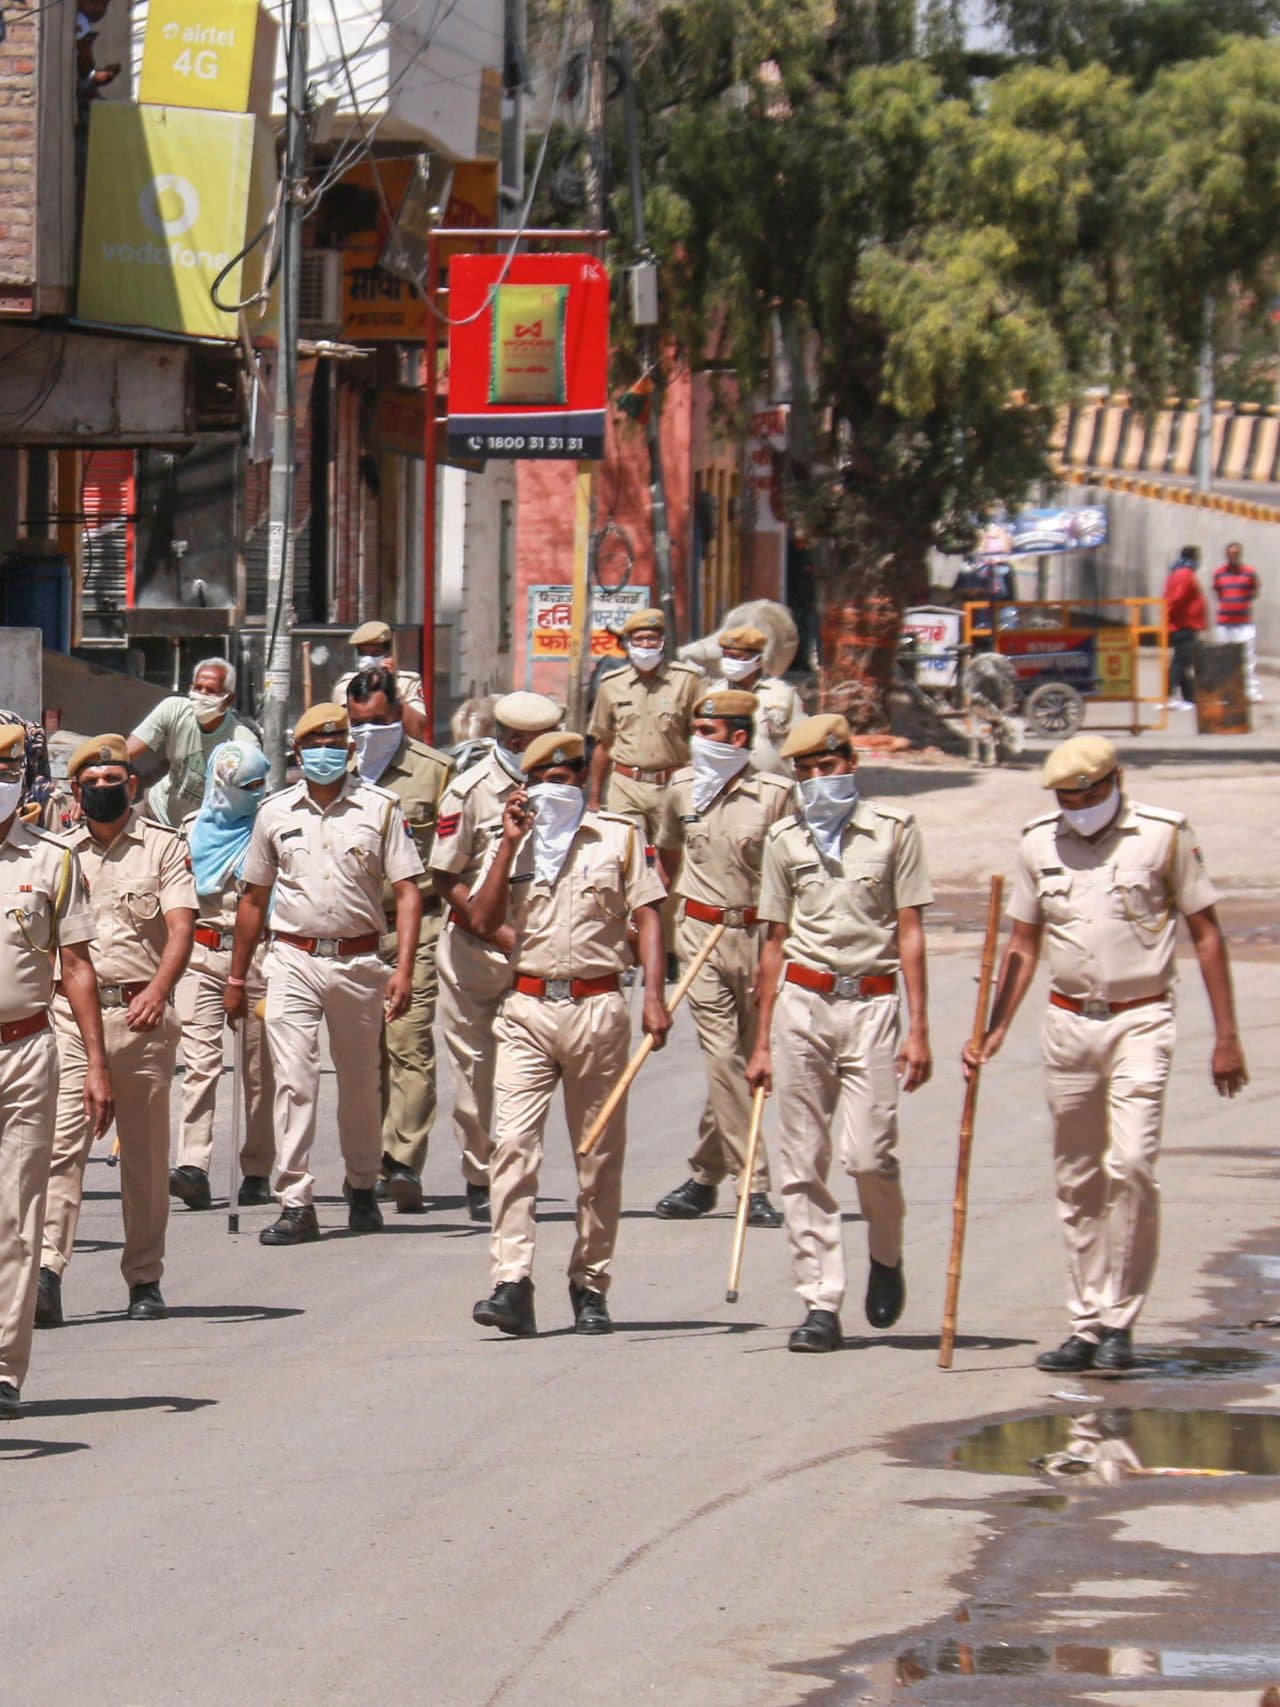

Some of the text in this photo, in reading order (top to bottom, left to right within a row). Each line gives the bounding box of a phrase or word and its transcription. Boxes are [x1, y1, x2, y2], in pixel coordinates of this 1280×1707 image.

[183, 22, 235, 47] airtel
[172, 49, 219, 80] 4G
[101, 242, 233, 270] vodafone
[488, 436, 584, 449] 1800 31 31 31
